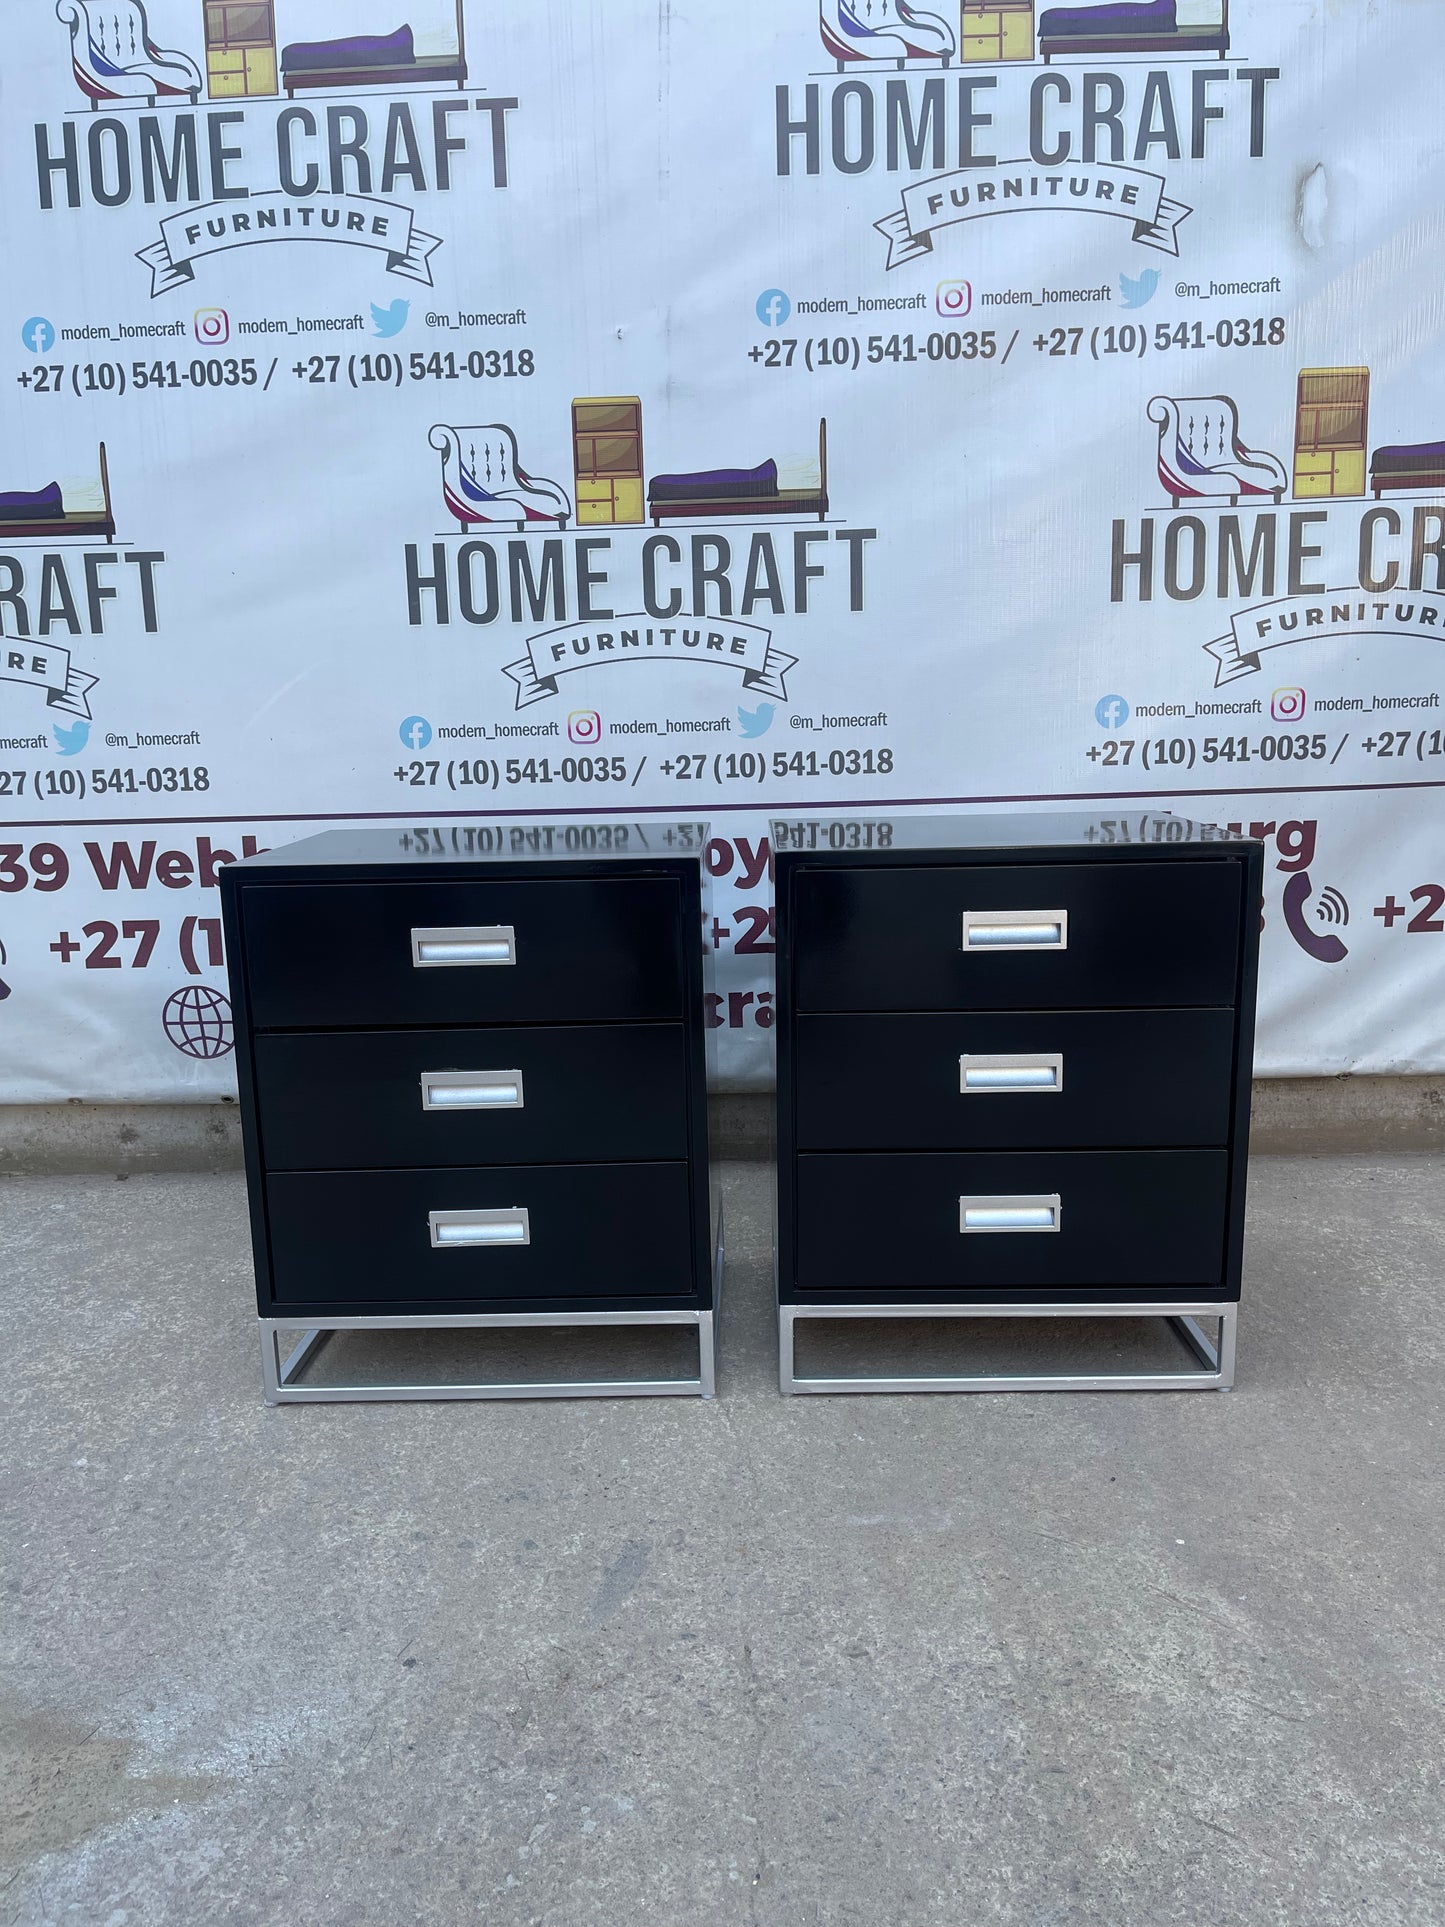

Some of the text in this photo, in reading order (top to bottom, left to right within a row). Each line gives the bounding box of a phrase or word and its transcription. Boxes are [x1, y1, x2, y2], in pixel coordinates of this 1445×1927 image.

[776, 67, 1280, 176] HOME CRAFT
[34, 97, 518, 209] HOME CRAFT
[927, 177, 1140, 215] FURNITURE
[185, 207, 390, 245] FURNITURE
[1175, 277, 1281, 299] @m_homecraft
[425, 309, 527, 329] @m_homecraft
[748, 339, 797, 367] +27
[805, 337, 860, 372] (10)
[867, 331, 996, 363] 541-0035
[1033, 328, 1083, 356] +27
[1091, 325, 1147, 360] (10)
[1154, 317, 1285, 350] 541-0318
[17, 365, 64, 392] +27
[72, 363, 125, 397] (10)
[133, 359, 257, 389] 541-0035
[292, 356, 340, 383] +27
[348, 354, 402, 388] (10)
[410, 349, 534, 380] 541-0318
[1111, 511, 1328, 602] HOME
[404, 528, 877, 625] HOME CRAFT
[1256, 603, 1445, 638] FURNITUR
[8, 652, 47, 674] RE
[550, 629, 749, 662] FURNITURE
[105, 731, 200, 746] @m_homecraft
[790, 712, 887, 729] @m_homecraft
[1086, 741, 1135, 766] +27
[1142, 739, 1195, 770] (10)
[1202, 734, 1326, 763] 541-0035
[1362, 731, 1411, 757] +27
[1416, 730, 1445, 761] (1
[34, 770, 85, 800] (10)
[92, 767, 209, 793] 541-0318
[394, 761, 440, 785] +27
[448, 760, 499, 790] (10)
[506, 757, 626, 784] 541-0035
[660, 755, 706, 779] +27
[714, 753, 766, 784] (10)
[773, 749, 893, 777] 541-0318
[50, 920, 160, 969] +27
